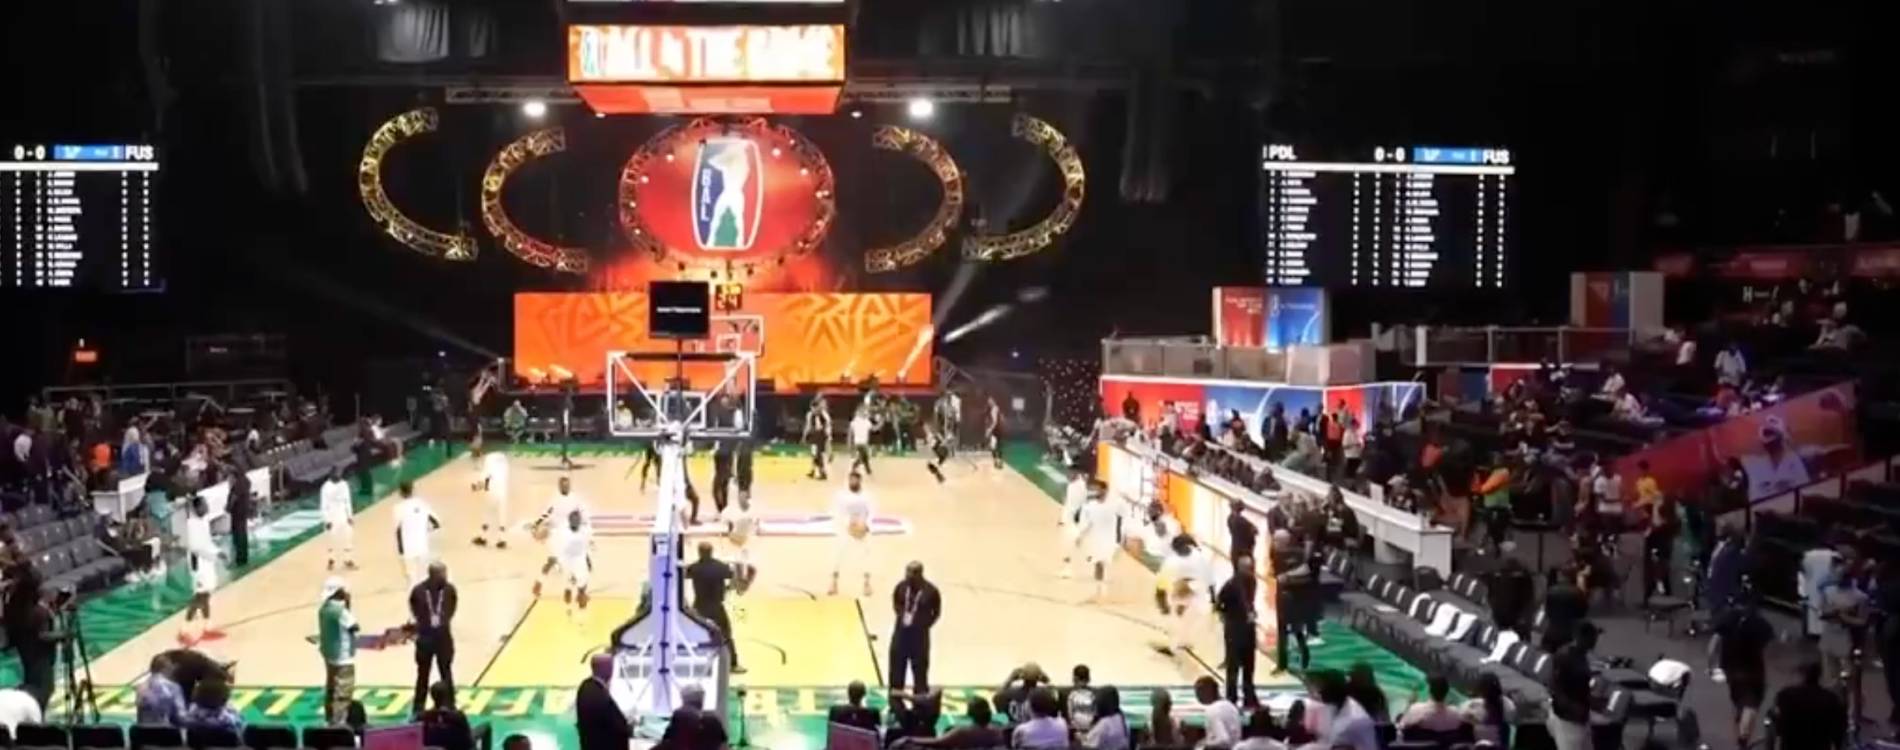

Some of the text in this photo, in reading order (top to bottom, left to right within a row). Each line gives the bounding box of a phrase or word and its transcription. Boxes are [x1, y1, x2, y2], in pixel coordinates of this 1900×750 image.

[125, 144, 154, 160] FUS
[1268, 144, 1298, 160] PDL
[1482, 148, 1510, 164] FUS
[700, 168, 712, 222] BAL
